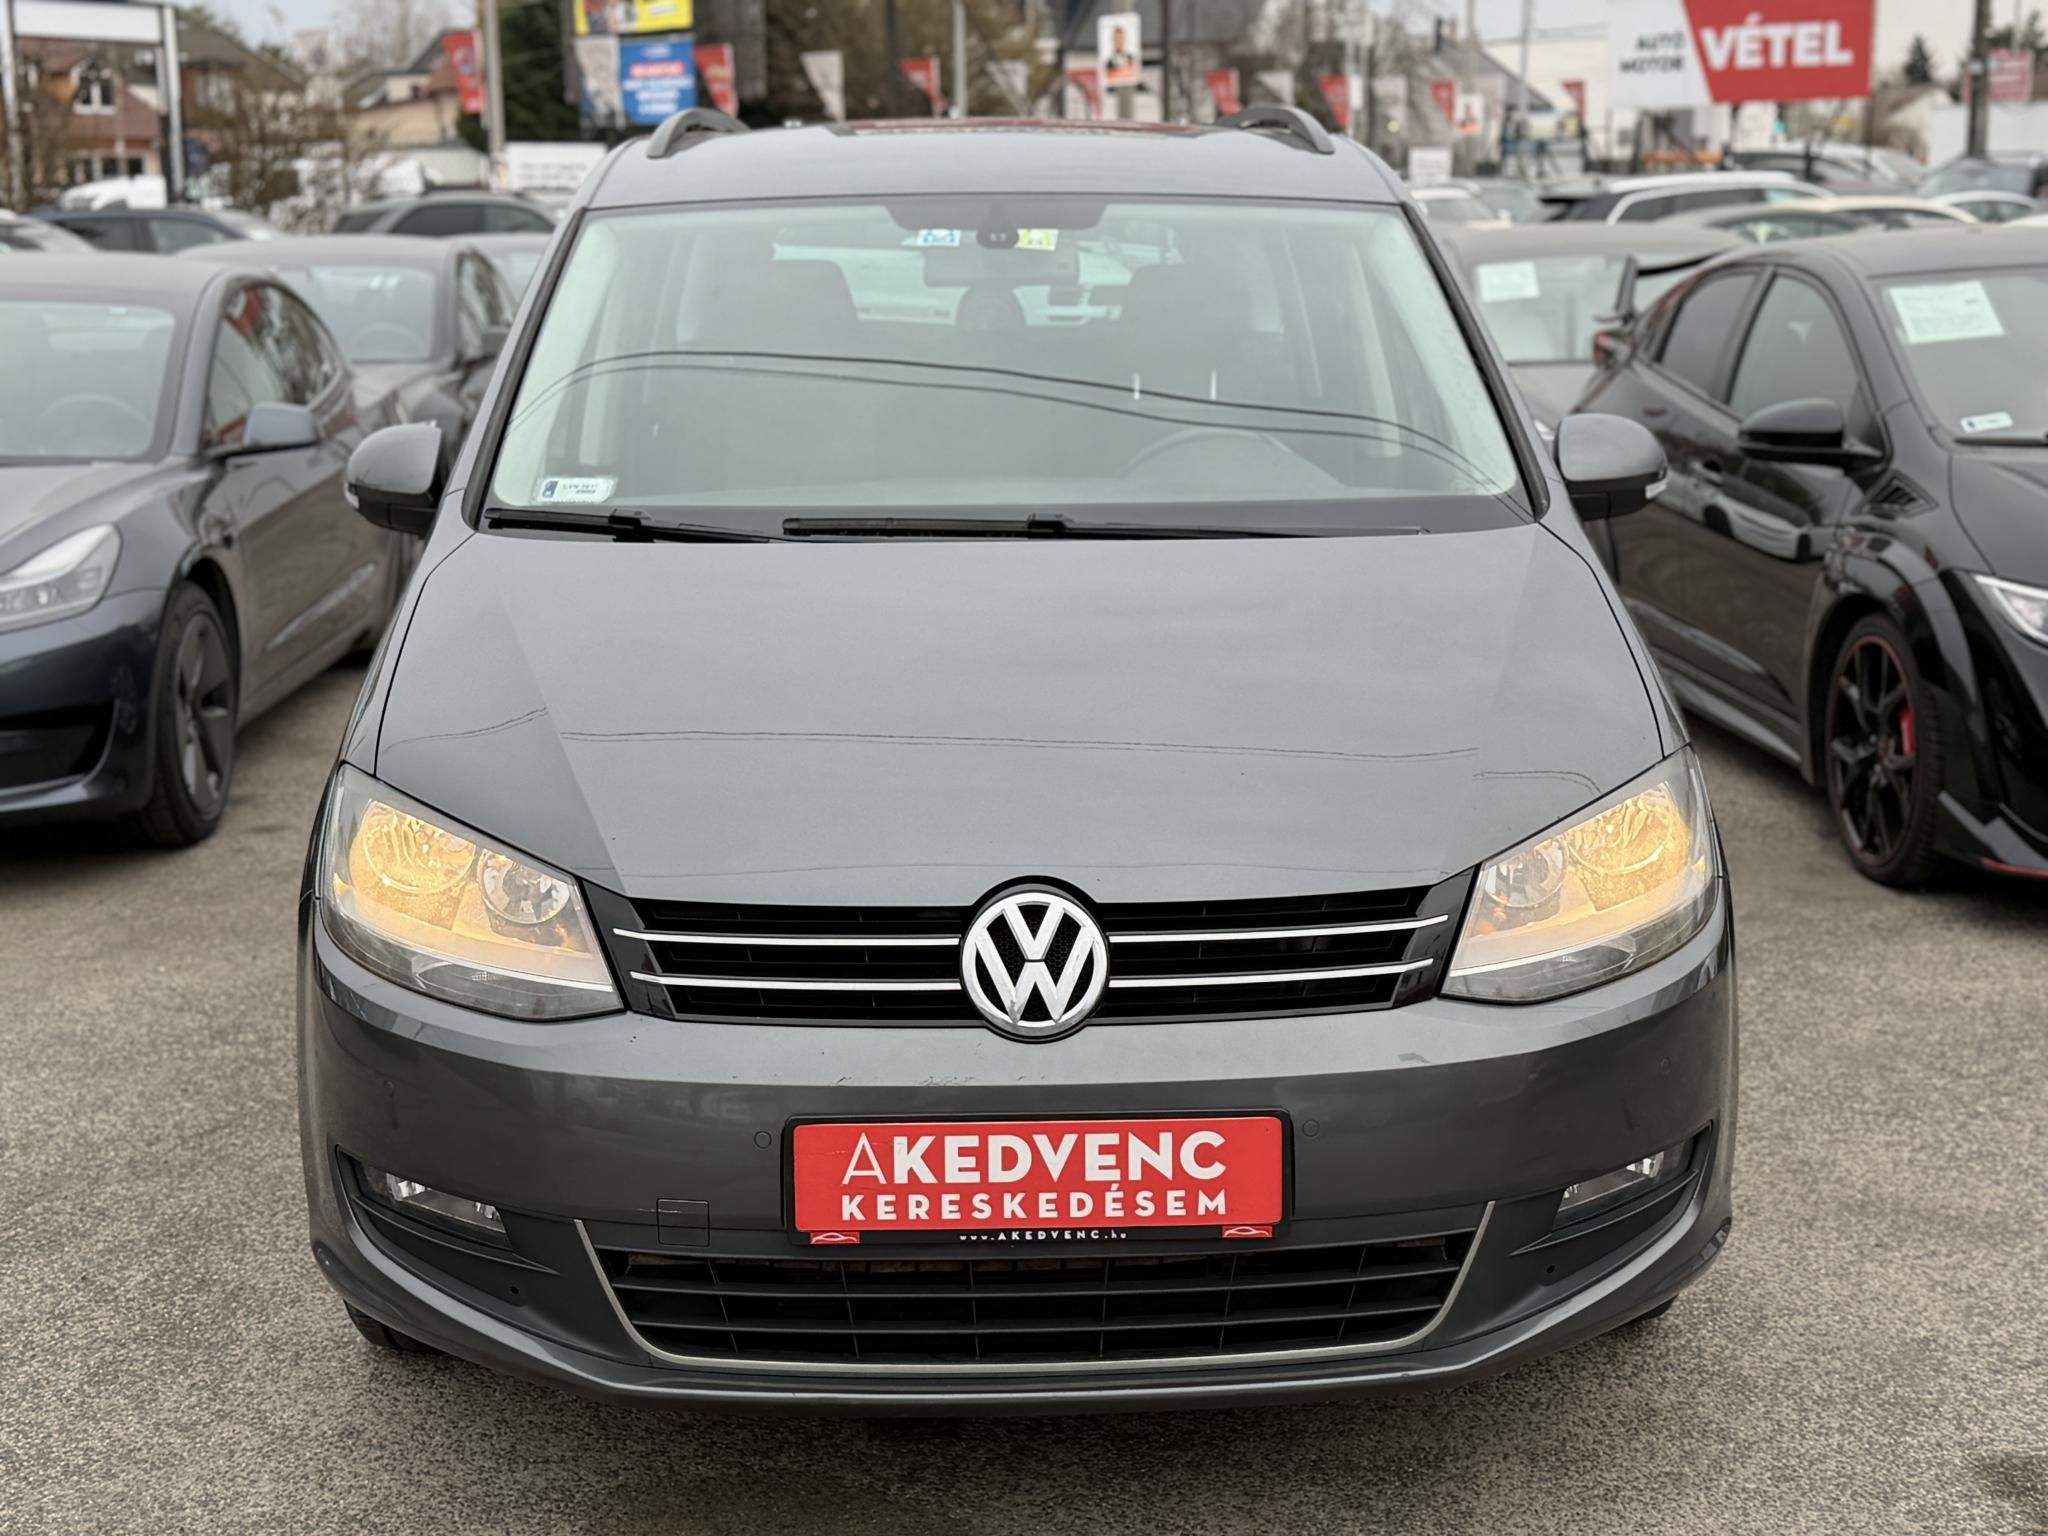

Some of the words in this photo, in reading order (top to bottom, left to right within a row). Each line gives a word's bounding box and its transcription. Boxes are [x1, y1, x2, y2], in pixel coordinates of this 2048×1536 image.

[1701, 12, 1854, 70] VÉTEL
[1618, 55, 1685, 74] MOTOR
[966, 893, 1104, 1028] VW
[841, 1130, 1227, 1185] AKEDVENC
[841, 1183, 1227, 1221] KERESKEDÉSEM
[959, 1229, 1127, 1241] www.AKEDVENC.hu
